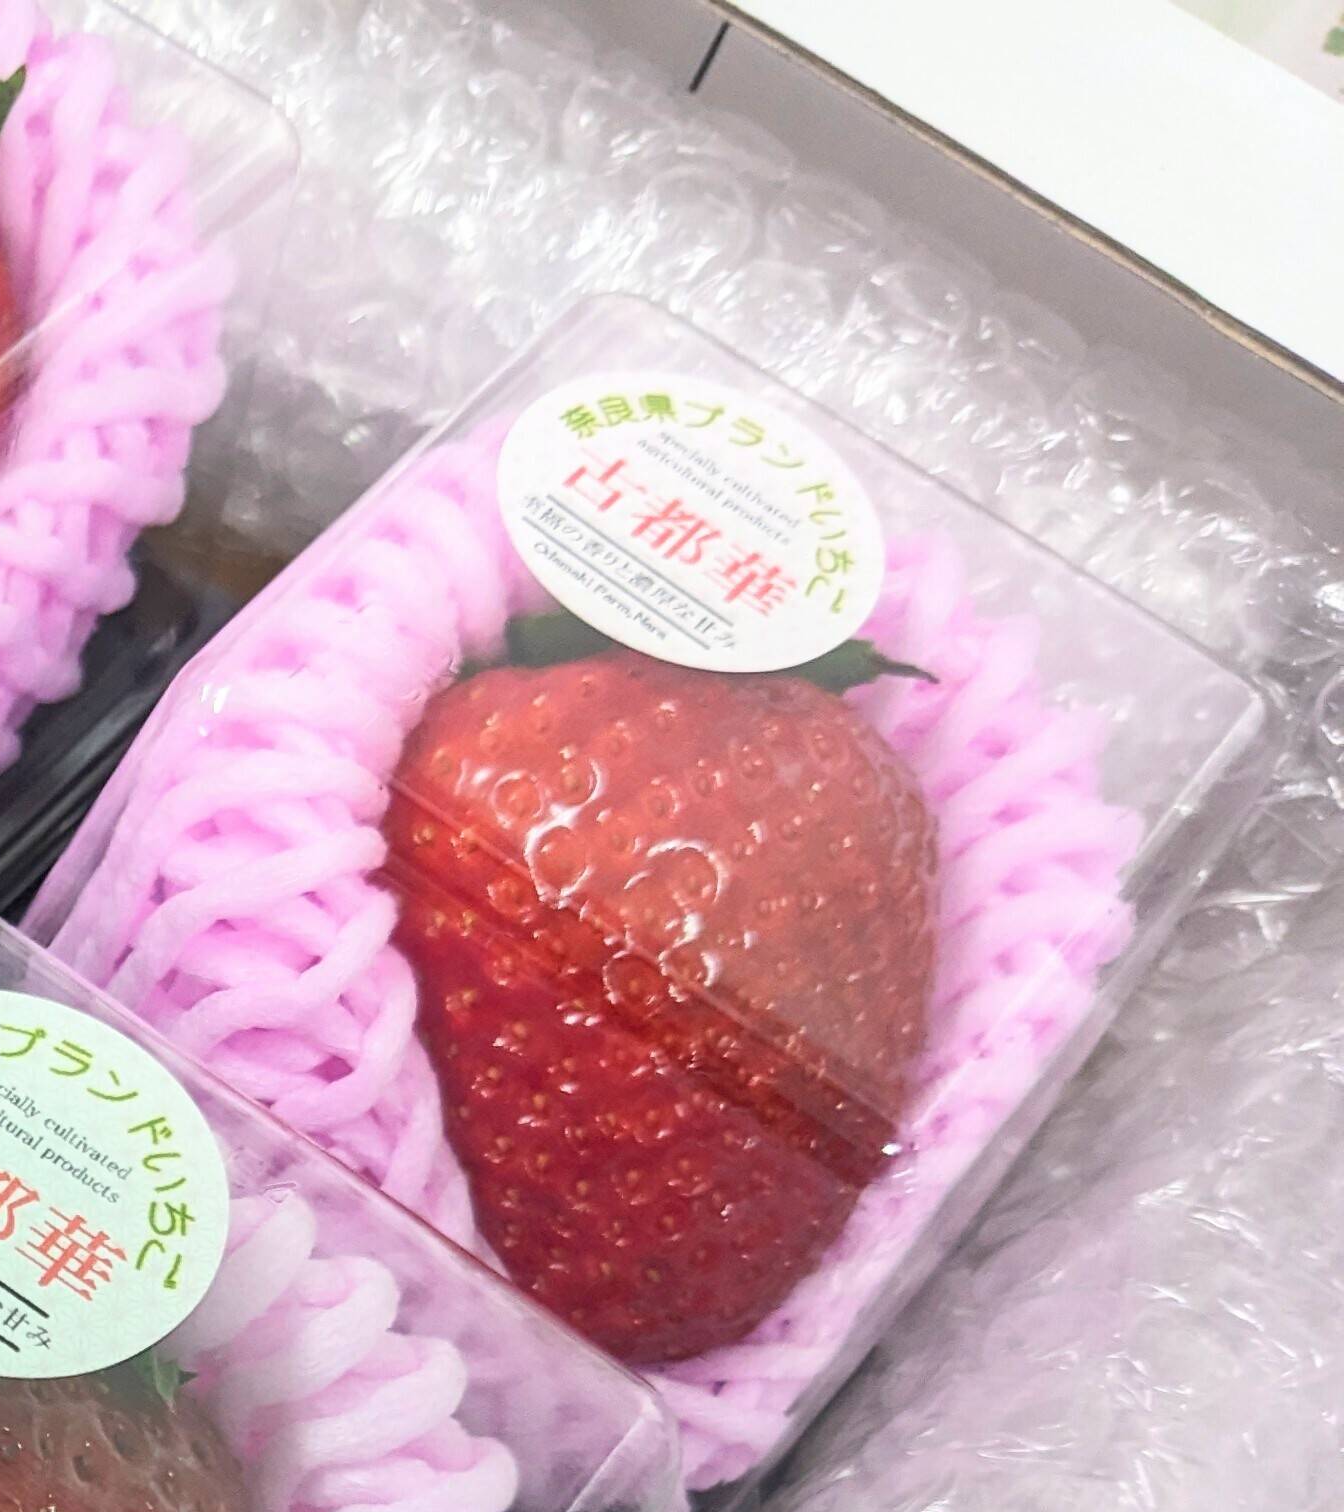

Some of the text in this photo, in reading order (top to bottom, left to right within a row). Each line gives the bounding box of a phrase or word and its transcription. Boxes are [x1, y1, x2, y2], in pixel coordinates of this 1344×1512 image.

[559, 393, 854, 614] 奈良県ブランドいちご
[561, 448, 798, 616] 古都華
[40, 1147, 121, 1204] products
[43, 1116, 133, 1180] cultivated
